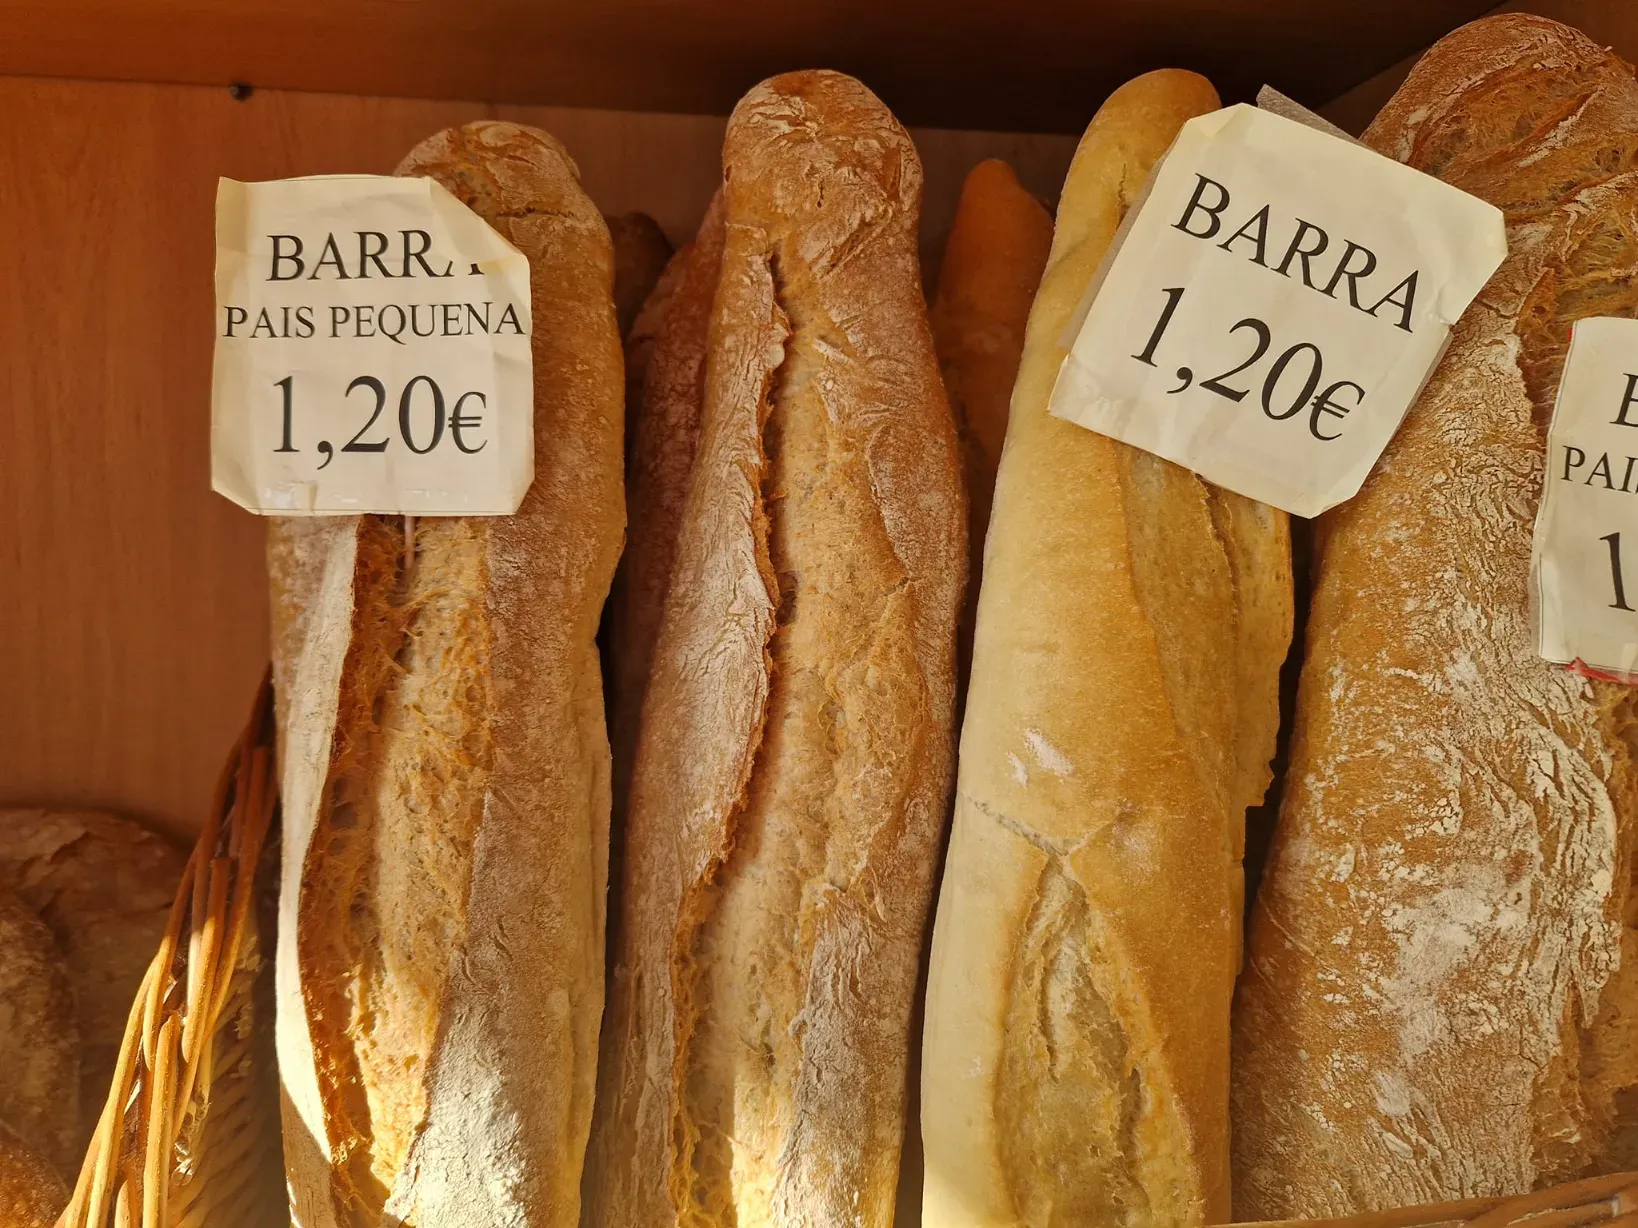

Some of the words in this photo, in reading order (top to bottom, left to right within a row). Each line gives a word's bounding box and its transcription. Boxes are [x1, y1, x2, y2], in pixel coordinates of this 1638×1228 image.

[265, 229, 486, 282] BARR
[1170, 172, 1420, 334] BARRA
[222, 305, 316, 339] PAIS
[328, 301, 526, 346] PEQUENA
[1130, 286, 1367, 442] 1,20€
[272, 374, 488, 471] 1,20€
[1560, 445, 1638, 494] PAI
